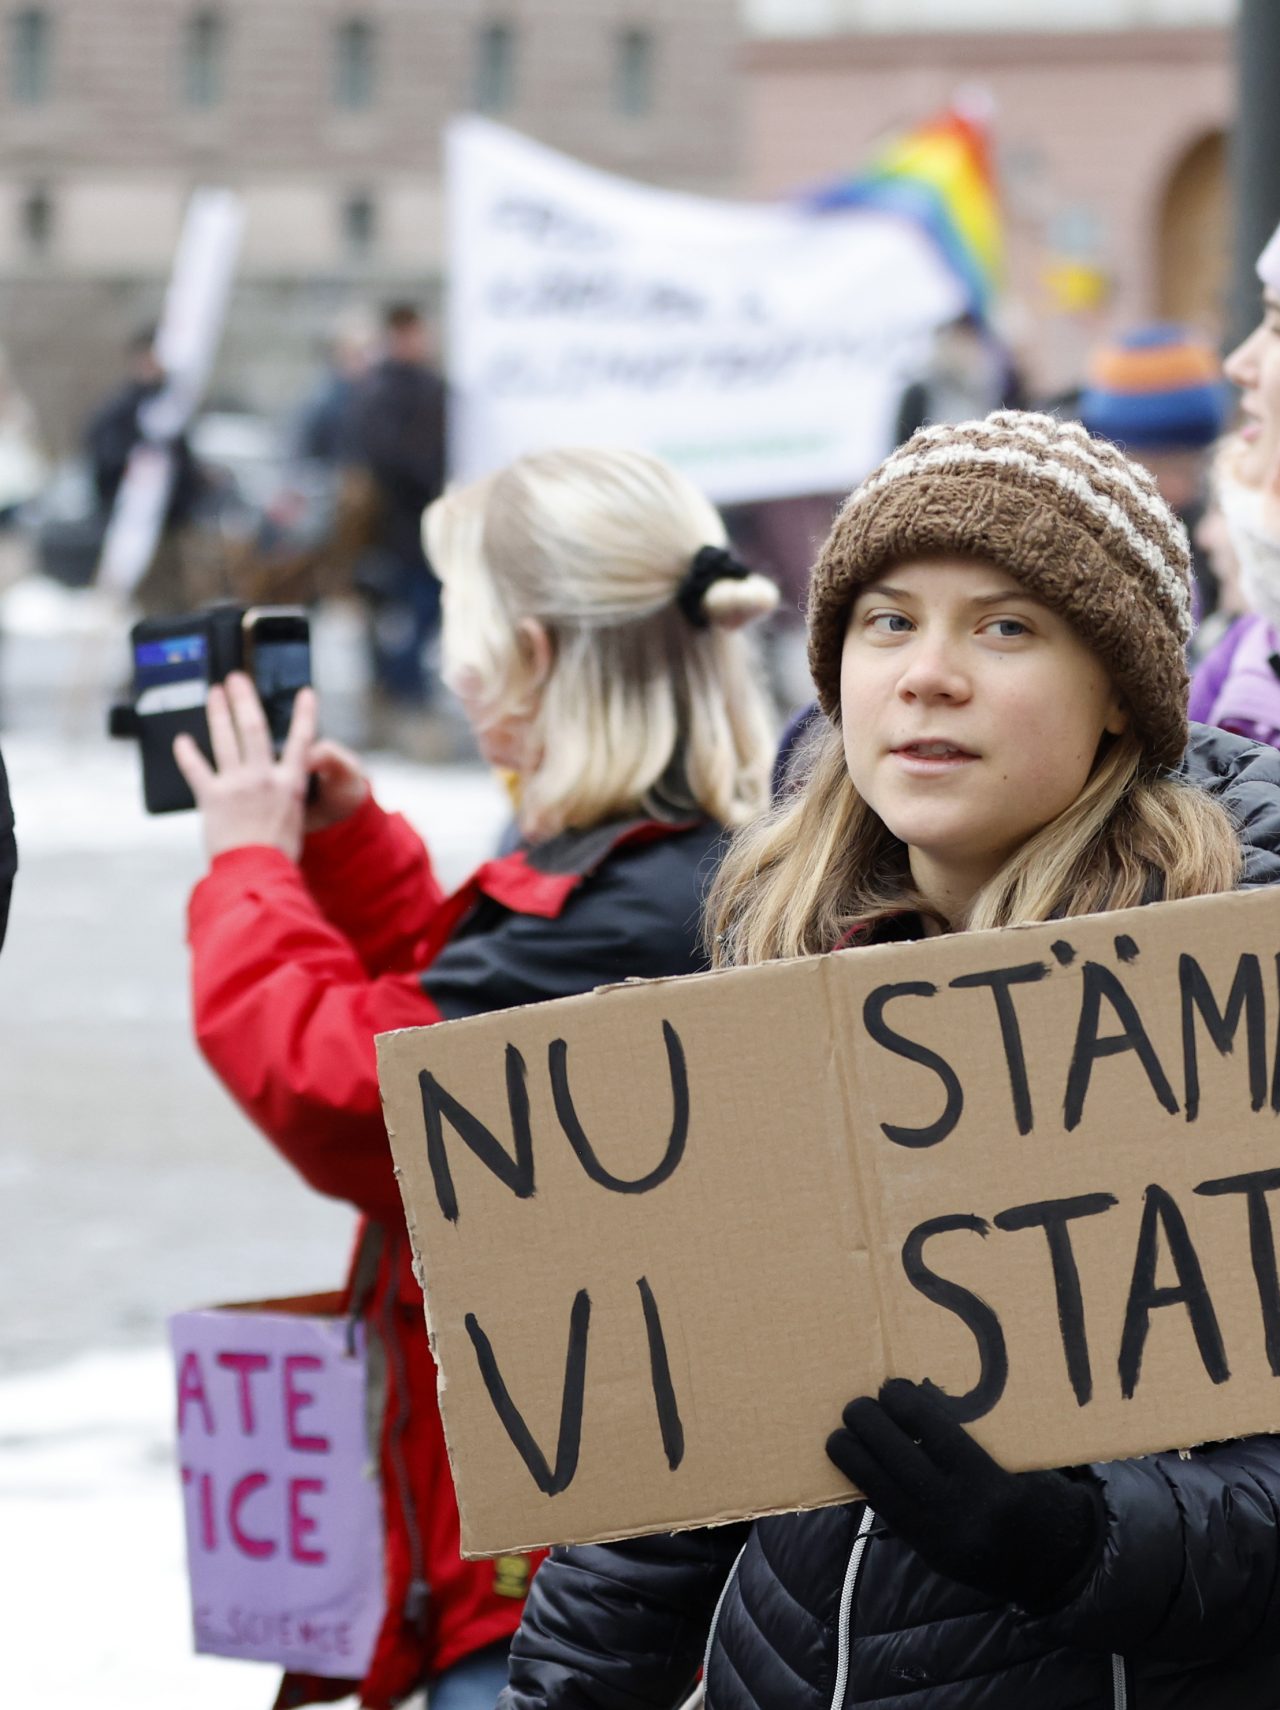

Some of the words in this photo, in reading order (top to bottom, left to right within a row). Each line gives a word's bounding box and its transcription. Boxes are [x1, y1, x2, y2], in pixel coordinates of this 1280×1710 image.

[418, 1019, 690, 1223] NU
[177, 1351, 332, 1453] ATE
[464, 1276, 685, 1498] VI
[181, 1466, 328, 1566] ICE
